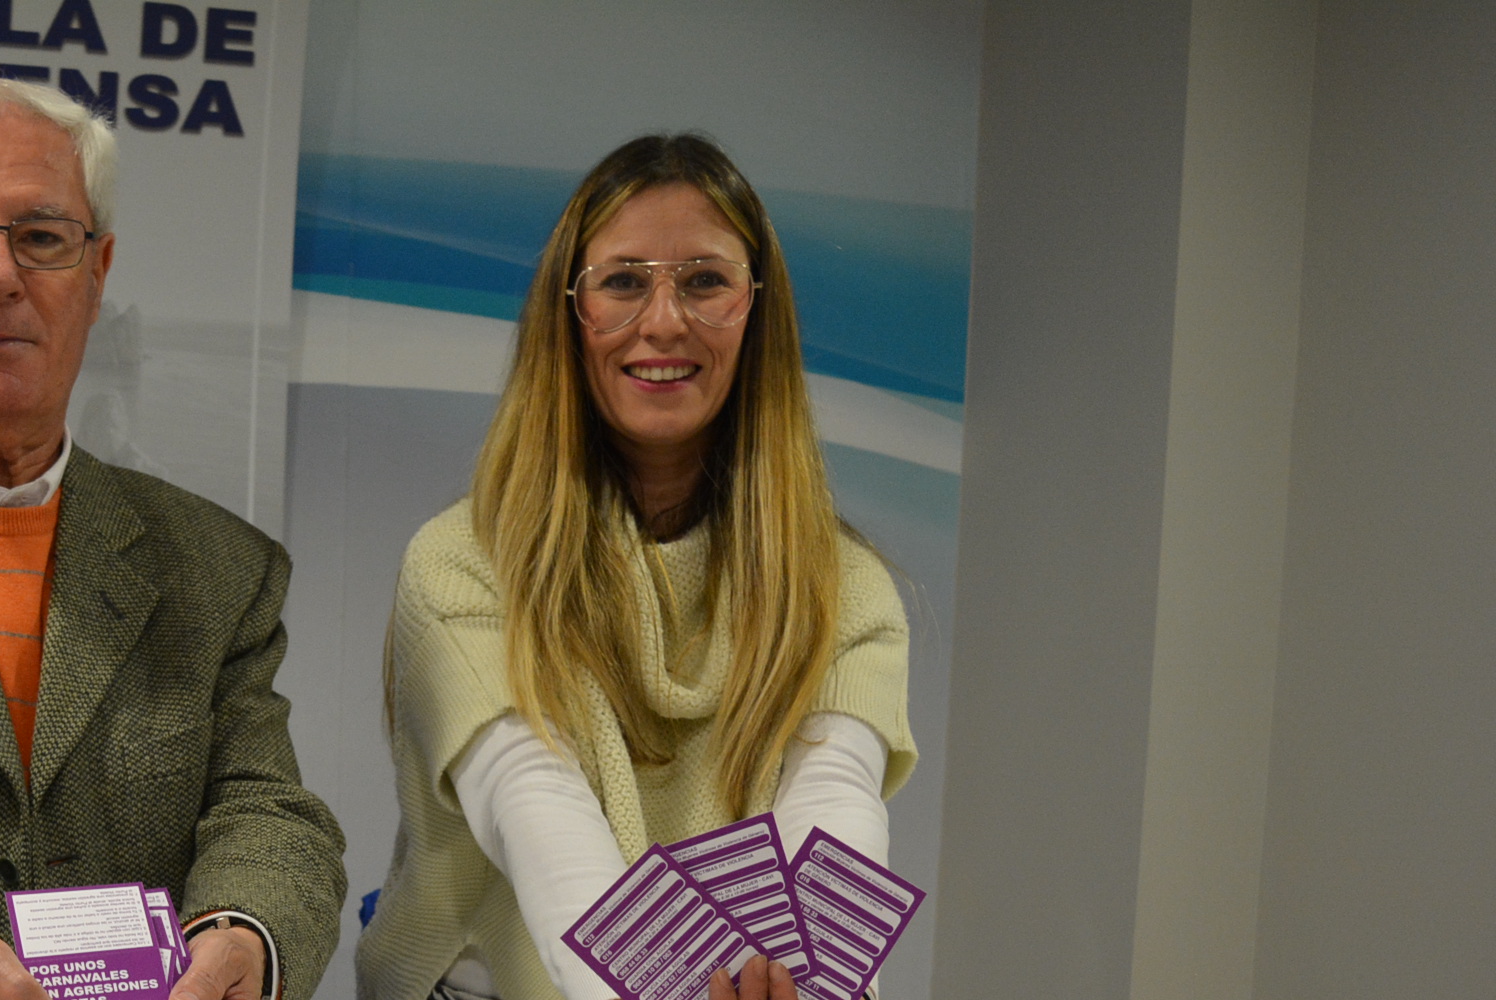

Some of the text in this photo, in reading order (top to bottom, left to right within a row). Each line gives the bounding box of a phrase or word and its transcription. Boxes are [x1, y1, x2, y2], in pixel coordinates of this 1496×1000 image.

[140, 1, 257, 67] DE
[813, 852, 824, 861] 112
[584, 933, 595, 943] 112
[29, 960, 106, 976] POR UNOS
[64, 979, 159, 998] AGRESIONES
